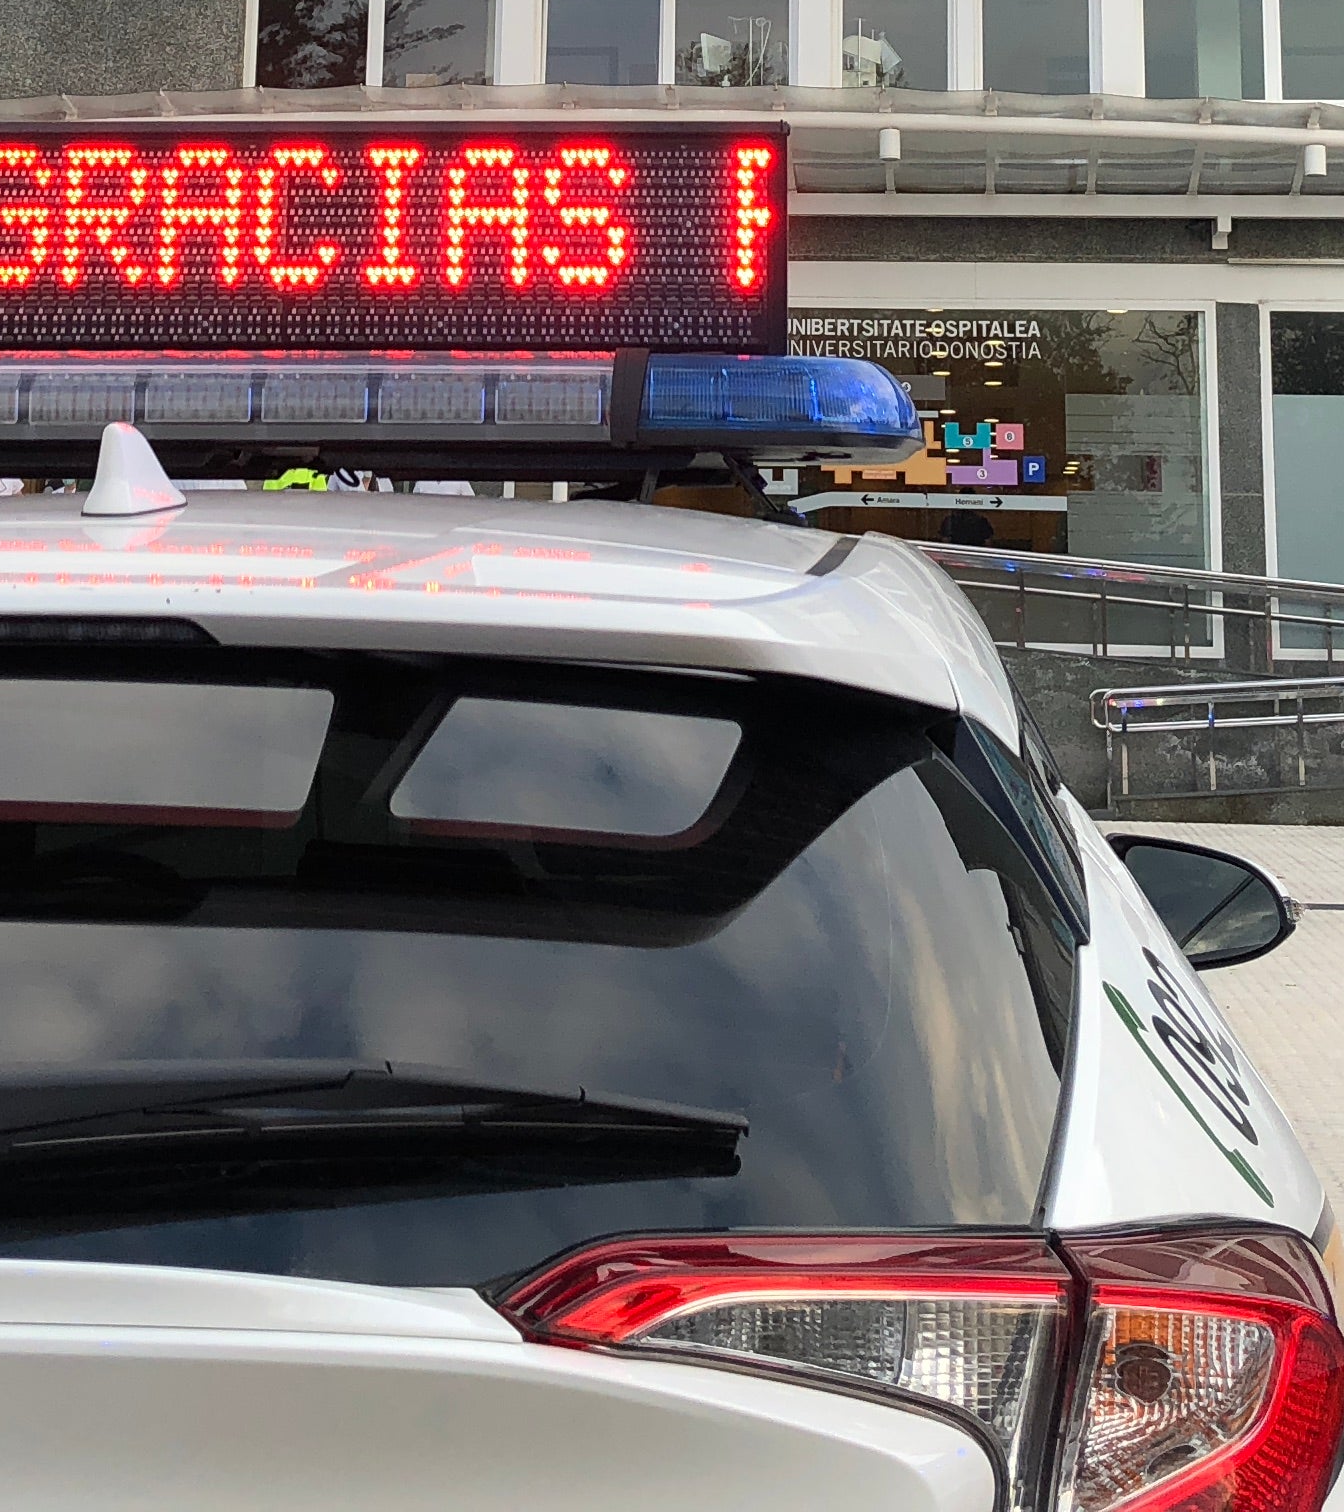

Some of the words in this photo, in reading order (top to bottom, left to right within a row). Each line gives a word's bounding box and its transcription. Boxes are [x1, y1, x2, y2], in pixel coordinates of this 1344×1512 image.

[931, 320, 1041, 338] OSPITALEA
[788, 339, 932, 358] NIVERSITARIO
[936, 340, 1041, 359] DONOSTIA
[1028, 463, 1039, 475] P
